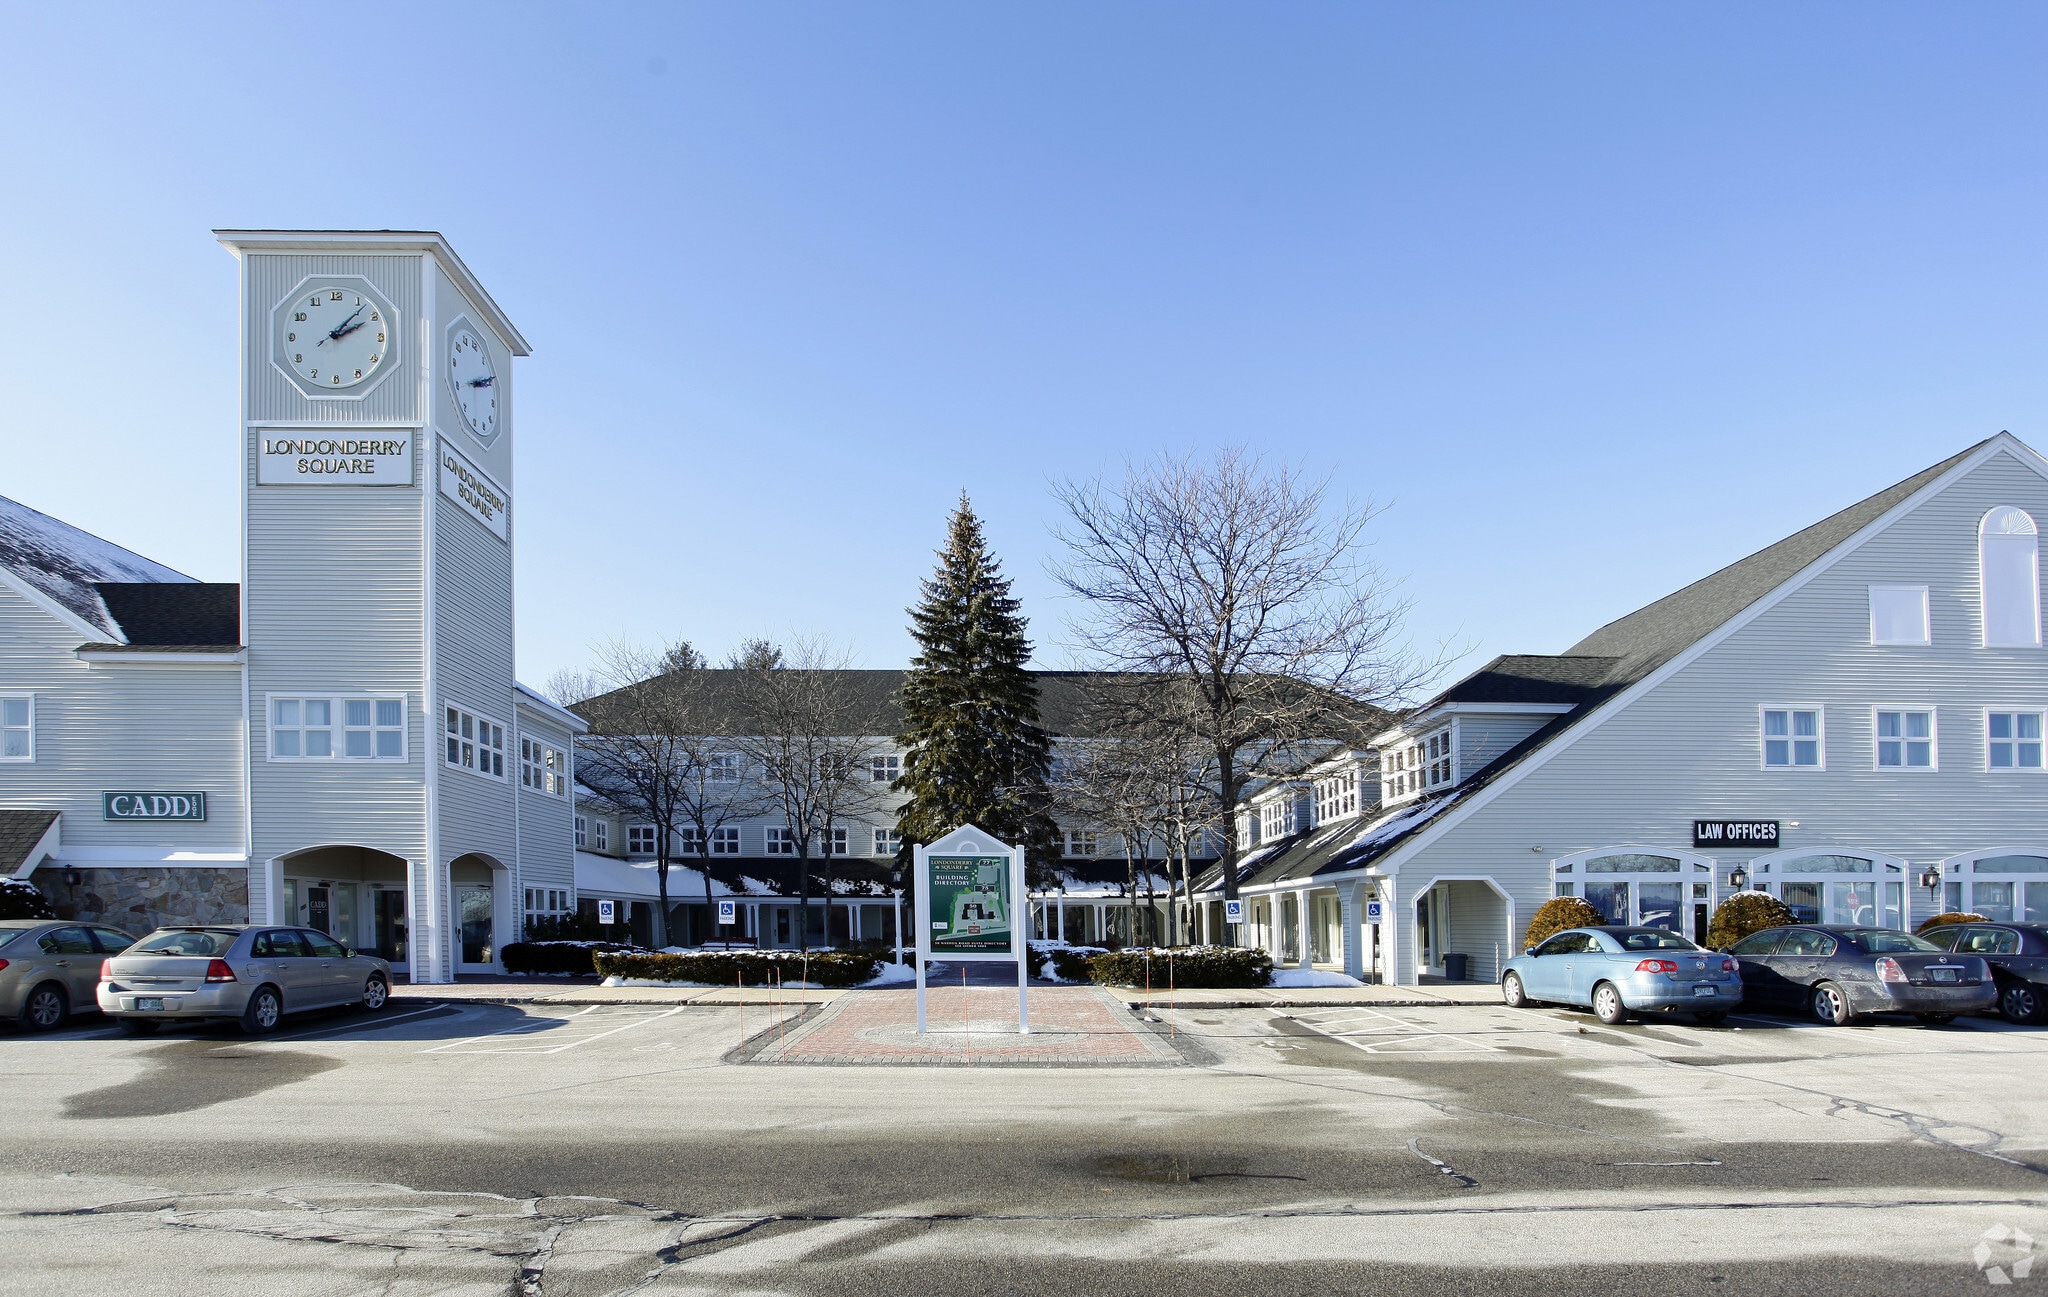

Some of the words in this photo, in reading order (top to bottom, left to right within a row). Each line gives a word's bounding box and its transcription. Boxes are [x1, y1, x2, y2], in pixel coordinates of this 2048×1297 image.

[330, 292, 343, 301] 12
[355, 297, 360, 306] 1
[310, 297, 321, 307] 11
[294, 312, 307, 322] 10
[370, 311, 379, 321] 2
[288, 332, 296, 342] 9
[376, 332, 385, 342] 3
[294, 353, 303, 363] 8
[369, 353, 379, 363] 4
[310, 369, 318, 378] 7
[353, 369, 362, 378] 5
[332, 375, 340, 384] 6
[264, 439, 406, 455] LONDONDERRY
[296, 458, 375, 474] SQUARE
[442, 451, 505, 514] LONDONDERRY
[457, 482, 493, 521] SQUARE
[111, 795, 190, 817] CADD
[1697, 823, 1723, 839] LAW
[1726, 823, 1777, 840] OFFICES
